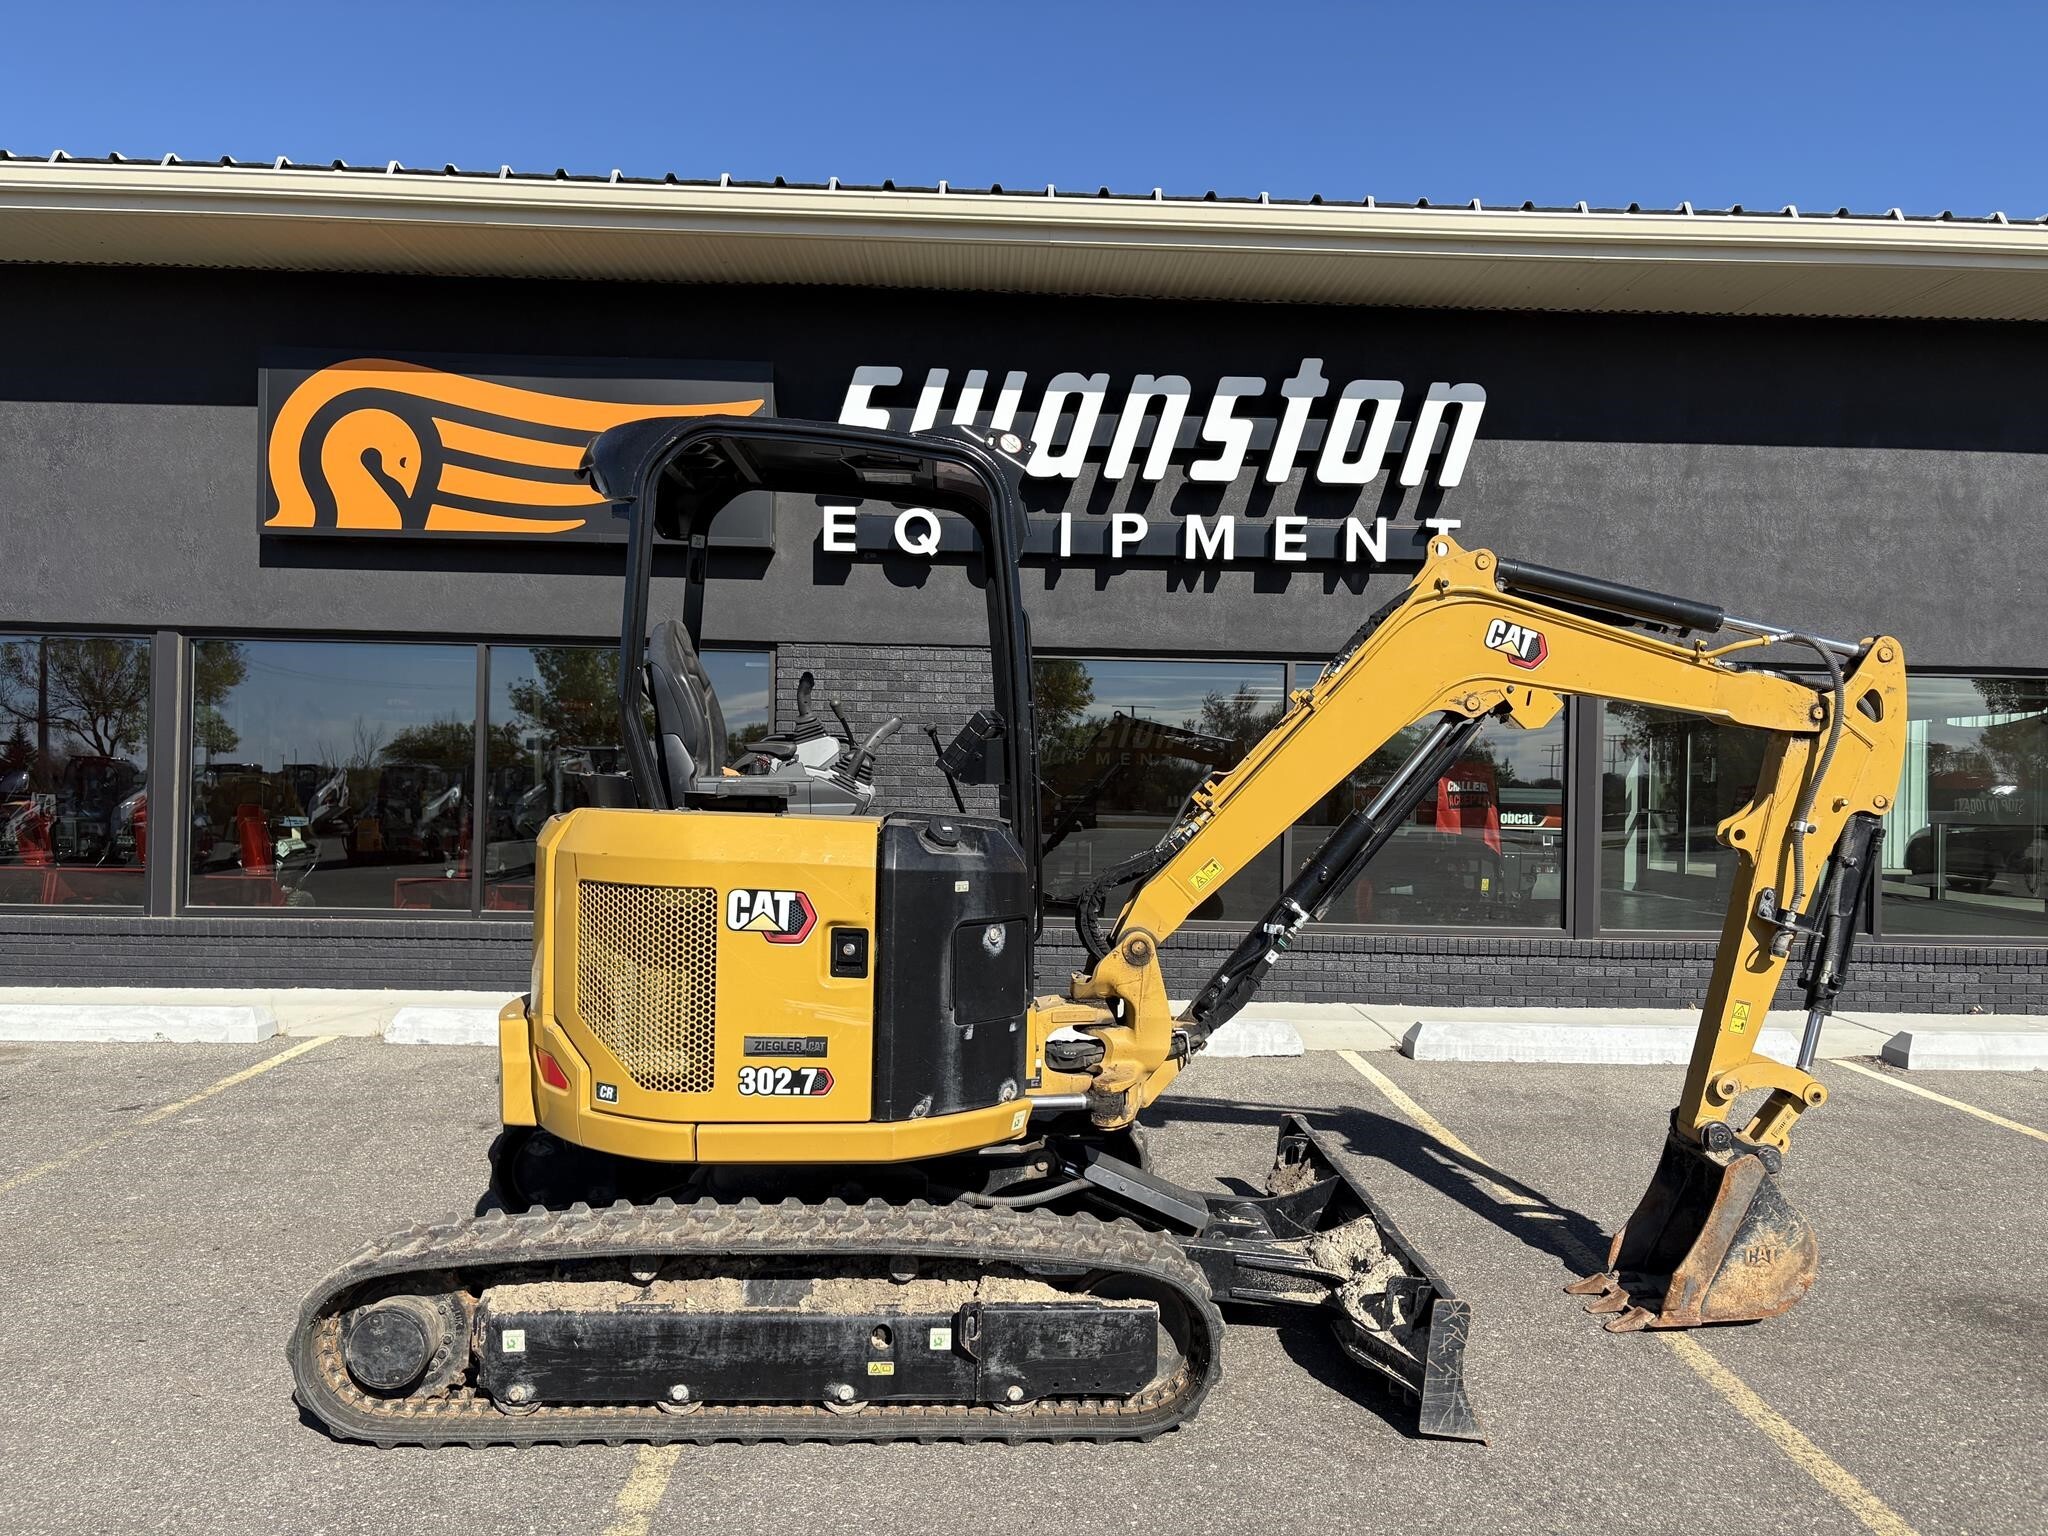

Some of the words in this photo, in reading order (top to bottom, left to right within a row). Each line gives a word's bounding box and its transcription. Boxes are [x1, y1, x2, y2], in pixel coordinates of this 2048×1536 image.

[822, 506, 1461, 562] EQIPMENT
[1485, 618, 1538, 659] CAT
[727, 889, 796, 931] CAT
[753, 1041, 802, 1052] ZIEGLER
[600, 1085, 614, 1100] CR
[739, 1067, 818, 1095] 302.7
[1745, 1245, 1776, 1265] CAT
